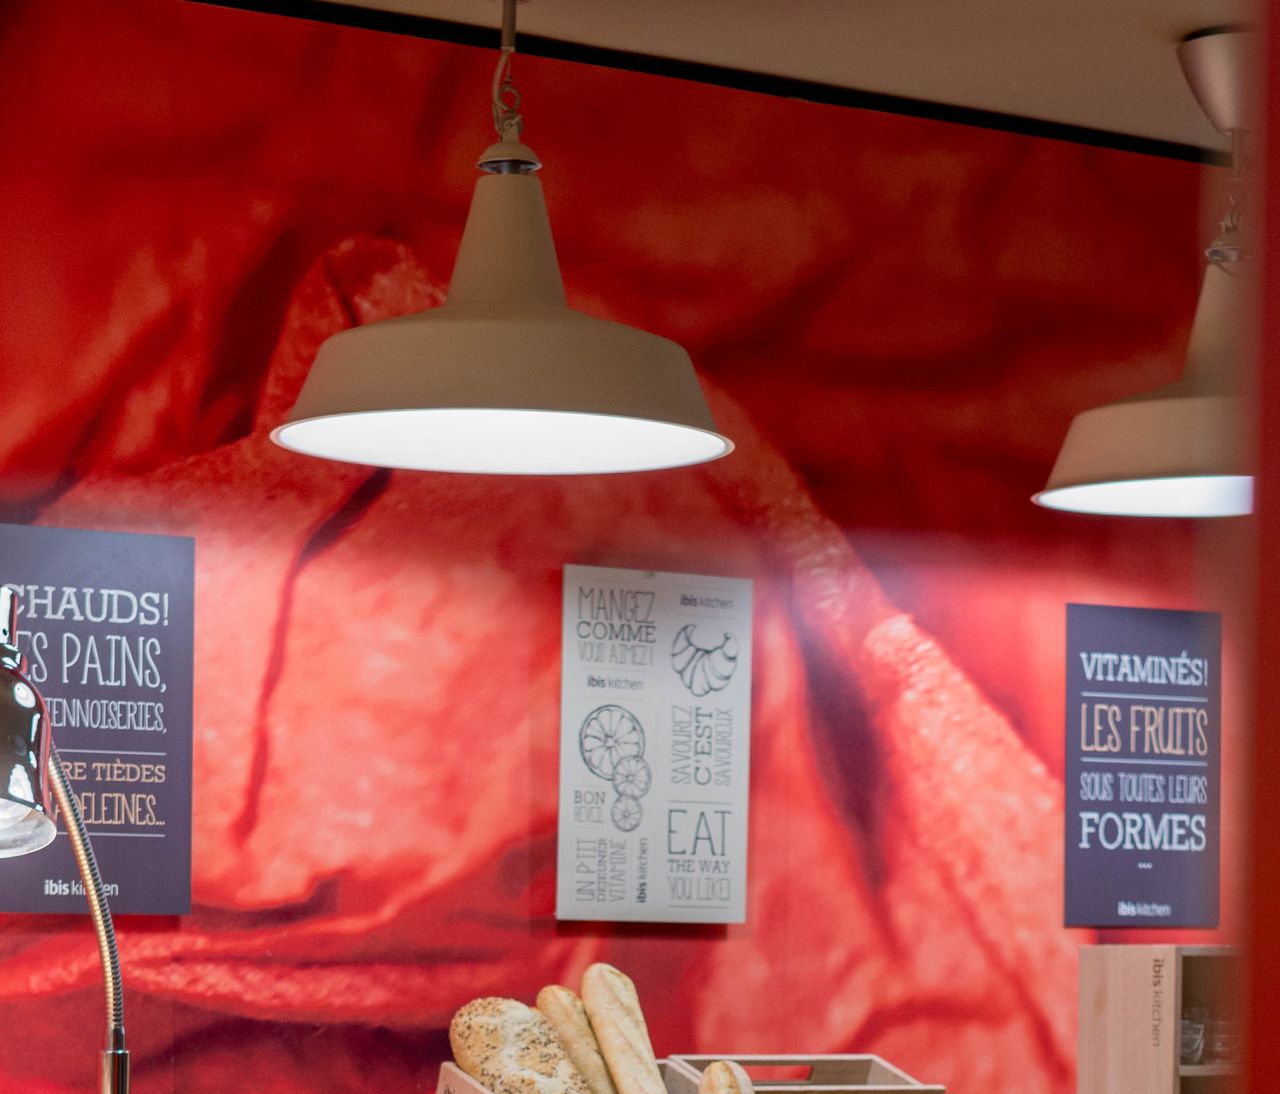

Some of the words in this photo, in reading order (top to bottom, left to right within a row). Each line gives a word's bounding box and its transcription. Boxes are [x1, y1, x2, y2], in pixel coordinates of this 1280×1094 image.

[578, 586, 656, 624] MANGEZ
[680, 594, 698, 607] ibis
[699, 596, 735, 609] kitchen
[577, 620, 656, 643] COMME
[62, 632, 167, 693] PAINS,
[1080, 651, 1208, 686] VITAMINÉS!
[587, 675, 607, 688] ibis
[609, 677, 644, 691] kitchen
[45, 697, 167, 734] IENNOISERIES,
[1081, 704, 1121, 752] LES
[1130, 705, 1208, 756] FRUITS
[672, 705, 693, 785] SAVOUREZ
[694, 706, 714, 786] C'EST
[715, 707, 733, 786] SAVOUREUX
[92, 758, 166, 783] TIÈDES
[574, 790, 606, 805] BON
[1080, 772, 1114, 801] SOUS
[1118, 772, 1165, 803] TOUTES
[1168, 774, 1208, 804] LEURS
[668, 809, 732, 857] EAT
[1079, 811, 1206, 852] FORMES
[637, 838, 648, 880] kitchen
[668, 859, 695, 873] THE
[700, 861, 730, 875] WAY
[44, 879, 69, 896] ibis
[576, 880, 596, 902] UN
[636, 882, 647, 903] ibis
[669, 876, 692, 900] YOU
[1118, 901, 1136, 917] ibis
[1136, 902, 1171, 917] kitchen
[1152, 959, 1165, 987] ibis
[1152, 991, 1164, 1047] kitchen
